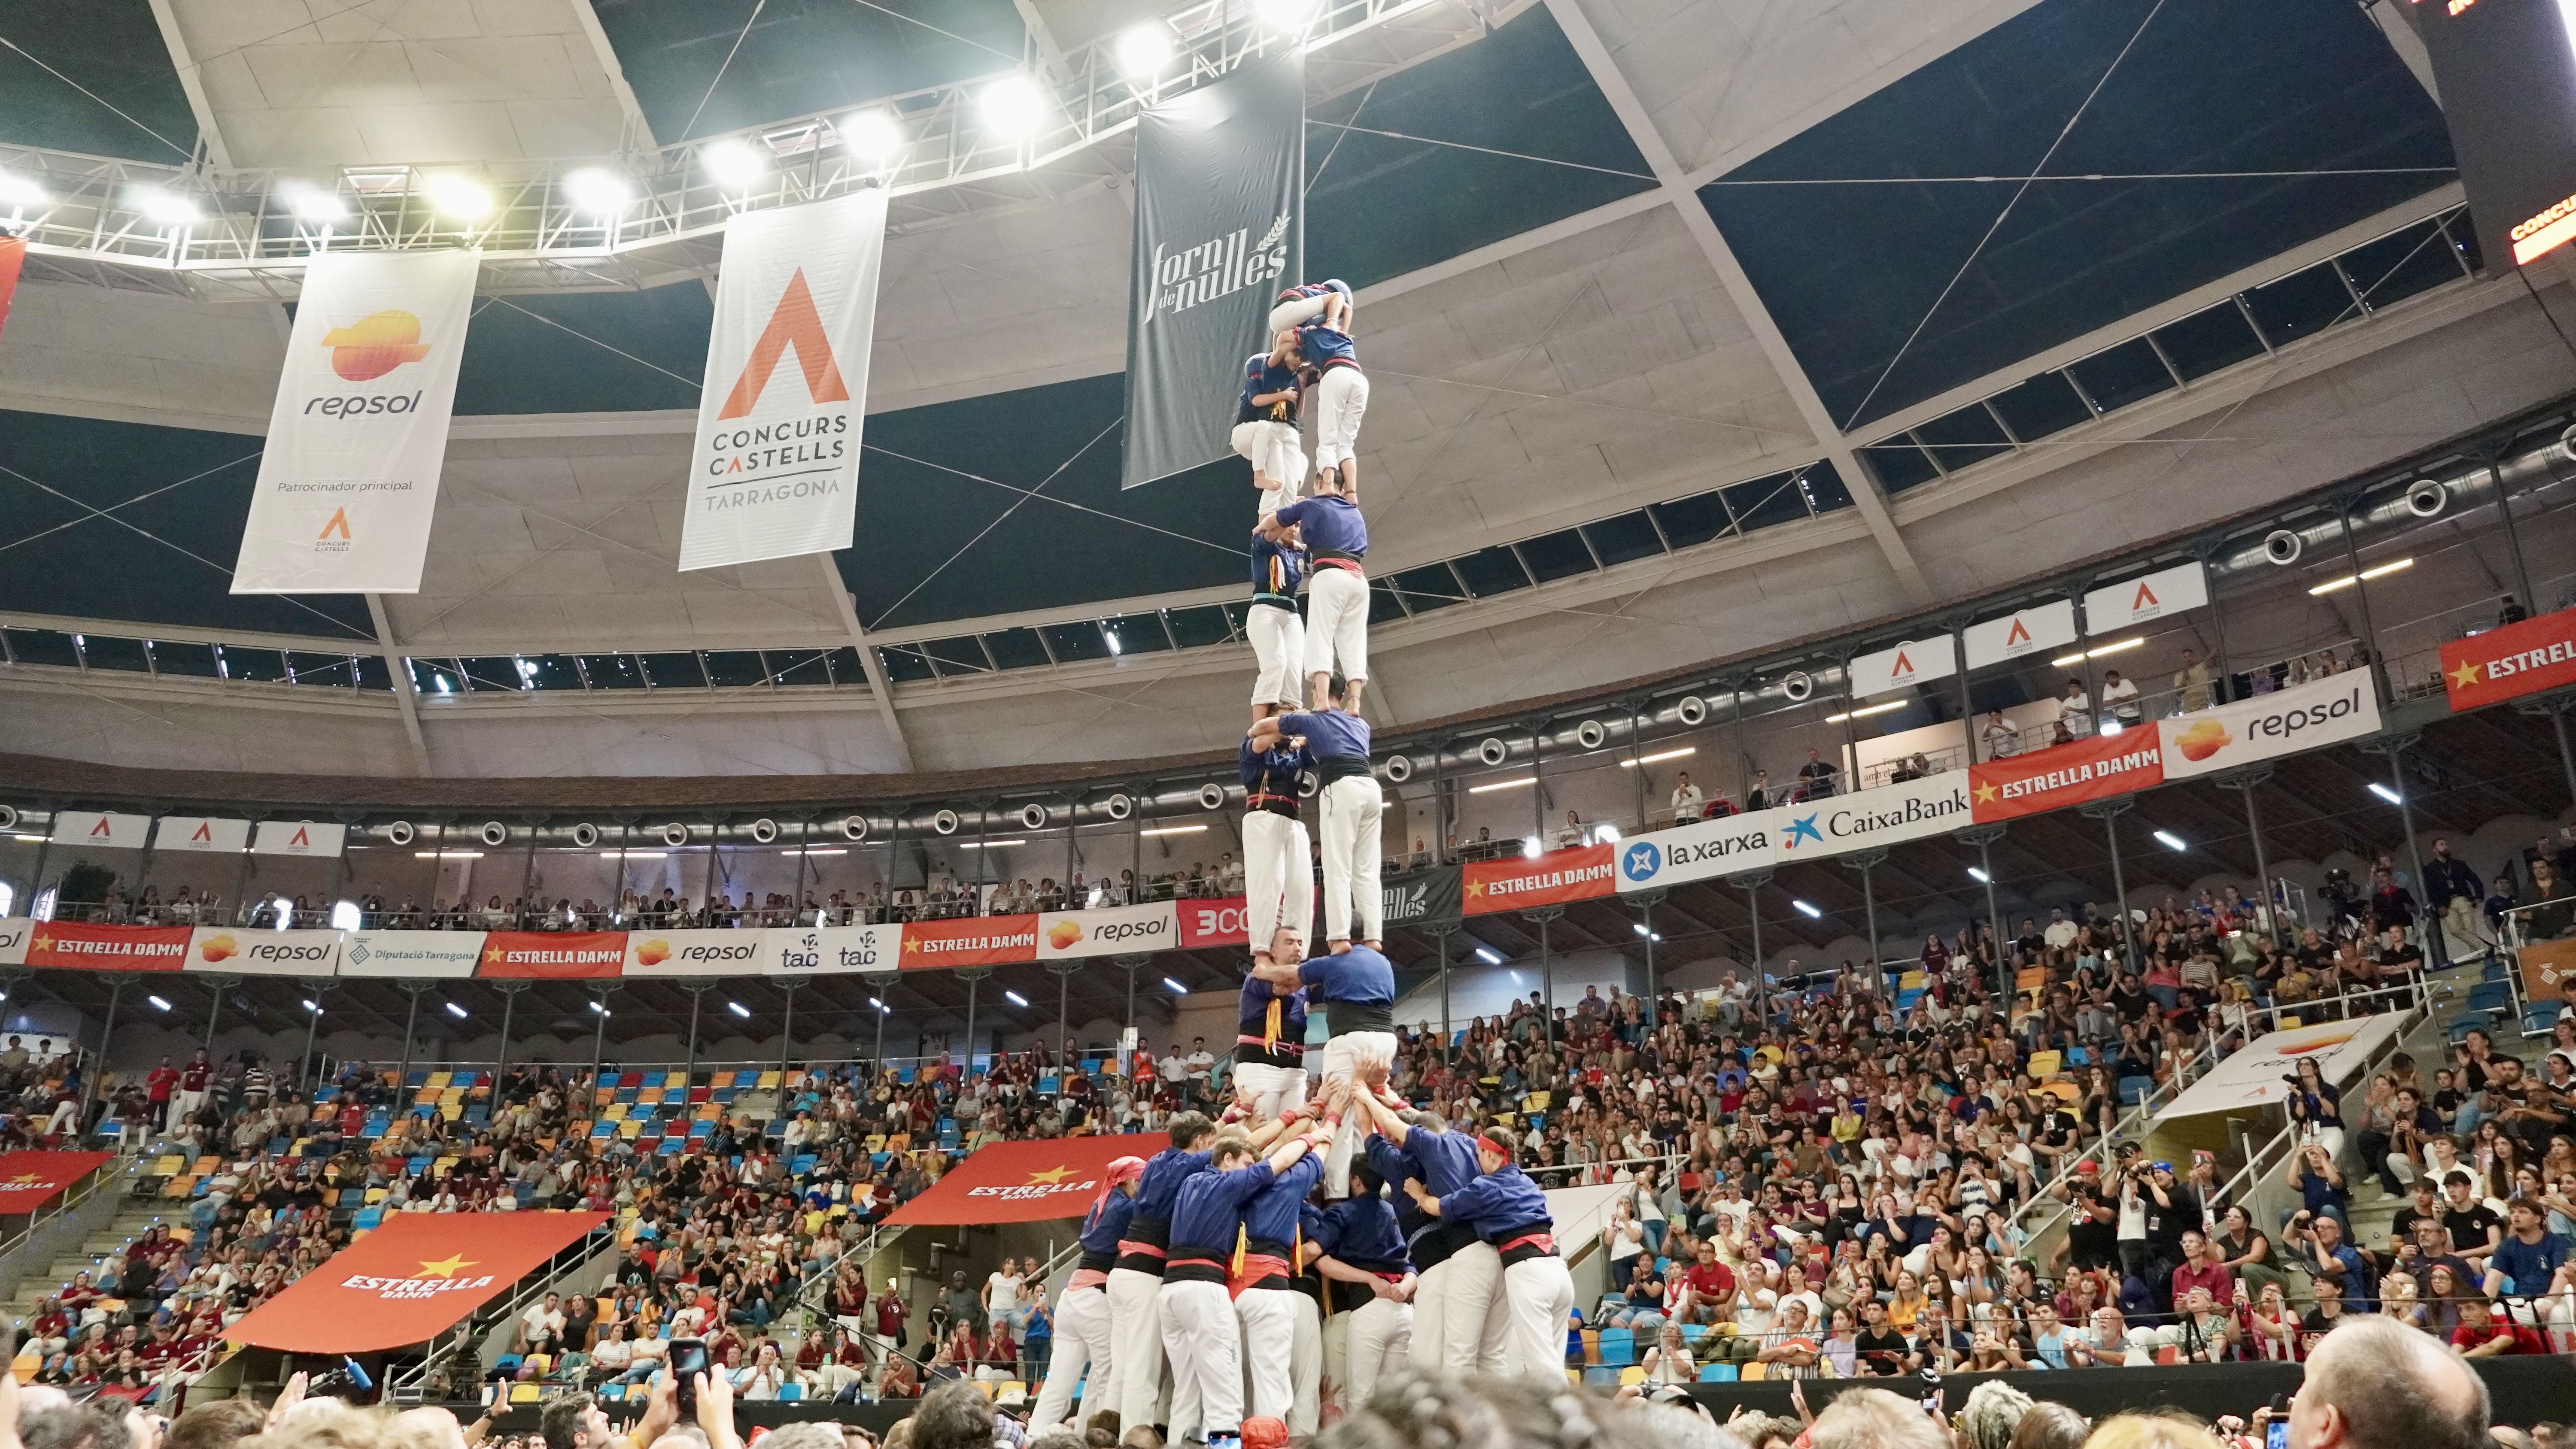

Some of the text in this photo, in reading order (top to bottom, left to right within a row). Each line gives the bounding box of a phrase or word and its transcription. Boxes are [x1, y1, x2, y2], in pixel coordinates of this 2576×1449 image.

[1142, 239, 1223, 324] forn
[1159, 289, 1175, 309] de
[304, 390, 423, 420] repsol
[713, 415, 847, 452] CONCURS
[710, 440, 844, 476] CASTELLS
[278, 481, 413, 492] Patrocinador principal
[705, 479, 840, 511] TARRAGONA
[2248, 688, 2360, 740] repsol
[2002, 748, 2159, 799] ESTRELLA DAMM
[1829, 788, 1969, 837] CaixaBank
[1668, 832, 1768, 867] la xarxa
[1488, 863, 1613, 896] ESTRELLA DAMM
[1094, 916, 1168, 942] repsol
[57, 939, 185, 956] ESTRELLA DAMM
[680, 943, 757, 963] repsol
[923, 932, 1035, 953] ESTRELLA DAMM
[249, 944, 331, 963] repsol
[375, 950, 474, 962] Diputació Tarragona
[506, 950, 622, 964] ESTRELLA DAMM
[781, 947, 876, 967] tac tac
[966, 1180, 1097, 1196] ESTRELLA
[340, 1274, 495, 1291] ESTRELLA
[380, 1291, 437, 1299] DAMM
